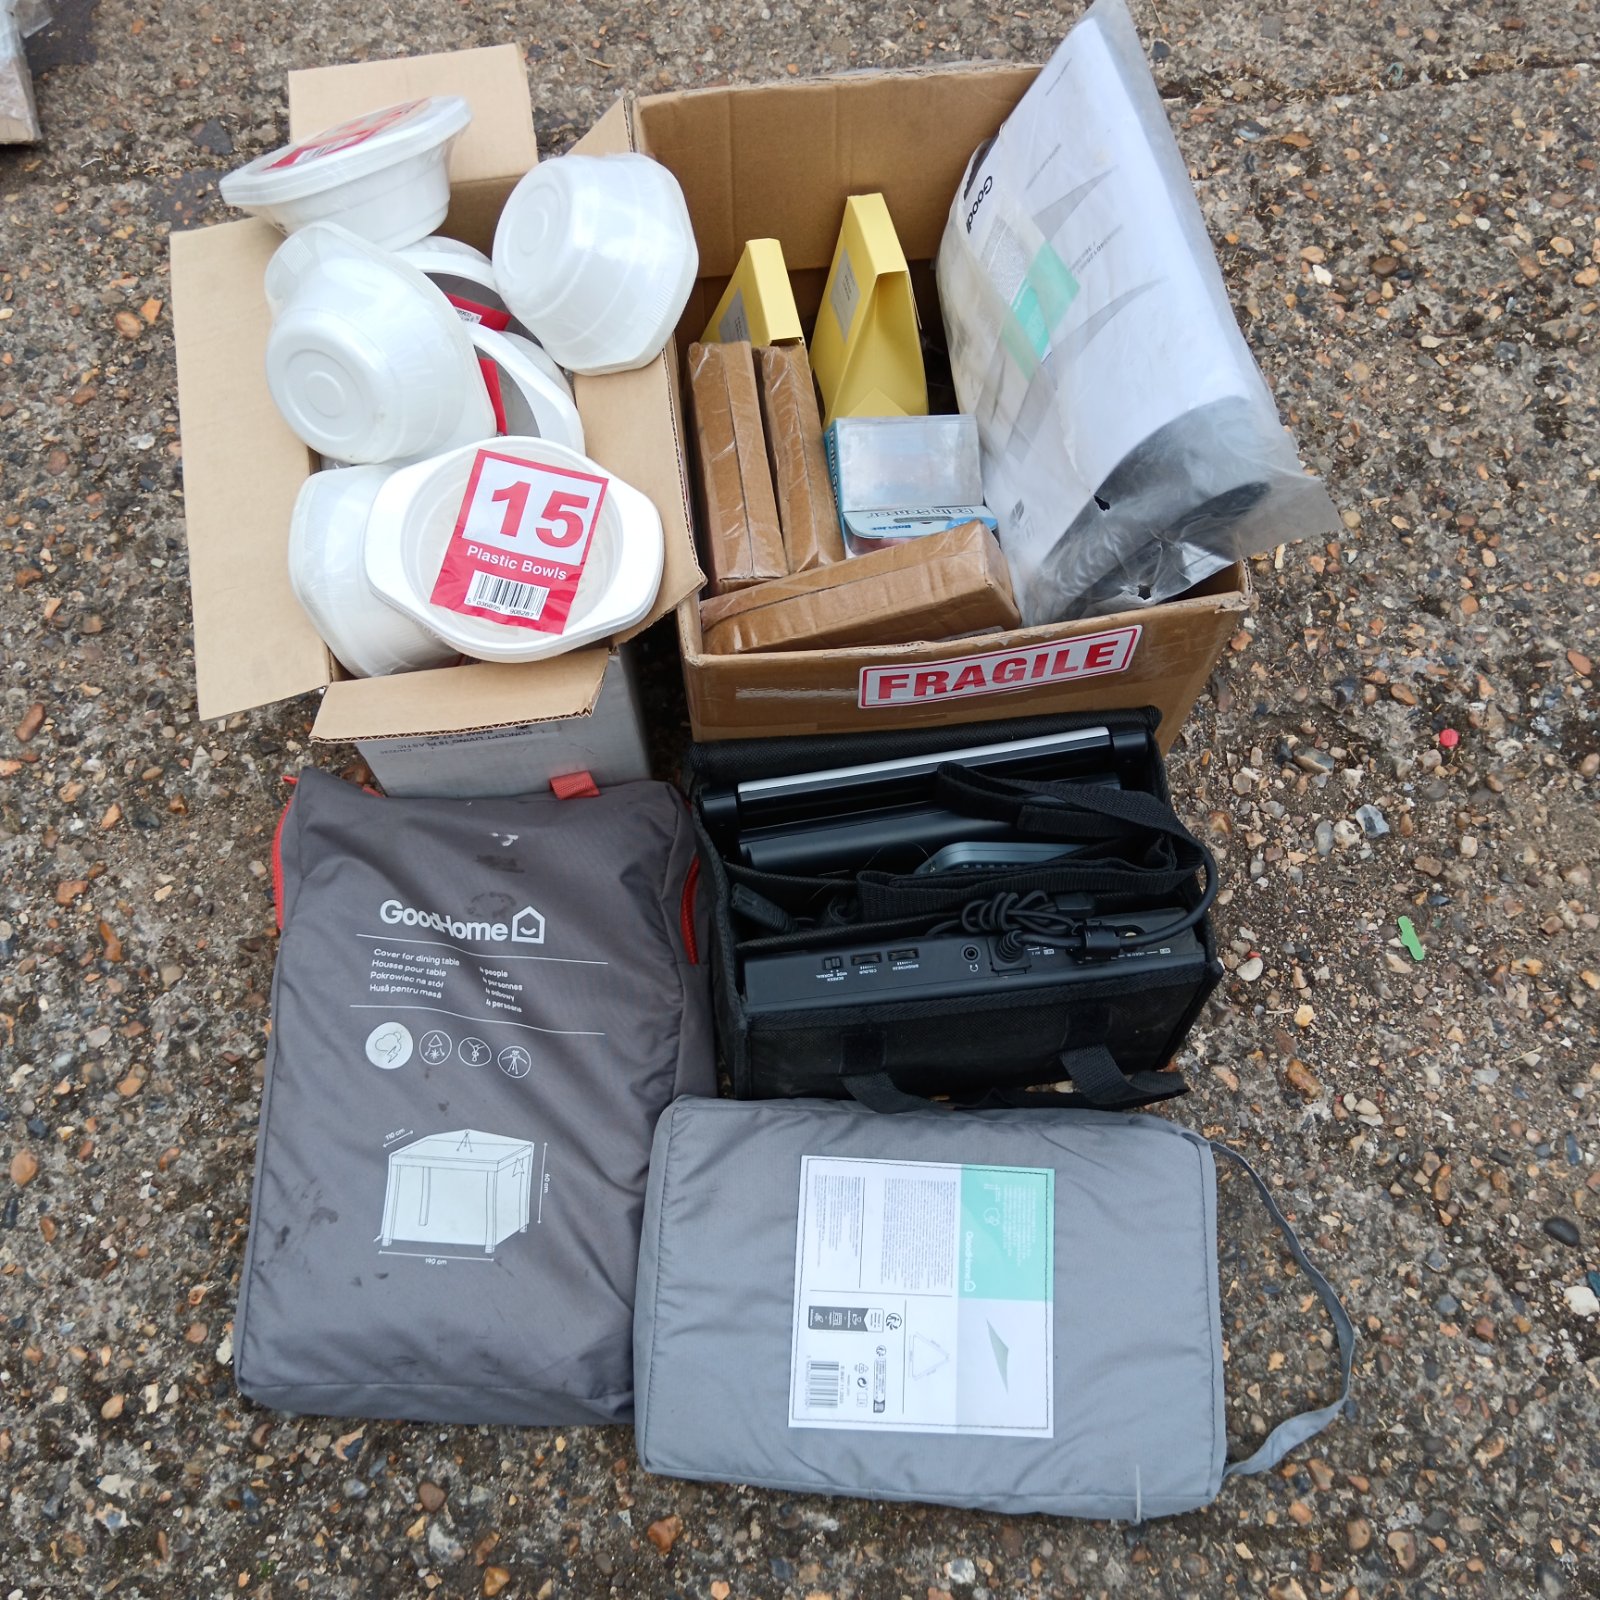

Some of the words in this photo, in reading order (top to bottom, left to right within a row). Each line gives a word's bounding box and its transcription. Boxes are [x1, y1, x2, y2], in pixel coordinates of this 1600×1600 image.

[492, 480, 590, 548] 15
[466, 545, 518, 570] Plastic
[521, 560, 567, 580] Bowls
[878, 640, 1119, 700] FRAGILE
[452, 736, 485, 745] LIVING
[488, 730, 533, 740] CONCEPT
[397, 741, 437, 749] PLASTIC
[380, 899, 509, 941] GoodHome
[373, 948, 401, 960] Cover
[402, 952, 414, 961] for
[416, 954, 441, 967] dining
[441, 956, 460, 967] table
[371, 959, 404, 970] Housse
[404, 963, 425, 975] pour
[426, 966, 447, 977] table
[484, 967, 508, 979] people
[370, 971, 415, 984] Pokrowiec
[415, 977, 427, 985] na
[488, 978, 523, 991] personnes
[390, 985, 419, 996] pentru
[485, 987, 491, 995] 4
[485, 999, 491, 1007] 4
[395, 1128, 406, 1137] cm
[544, 1173, 550, 1182] 60
[543, 1182, 549, 1193] cm
